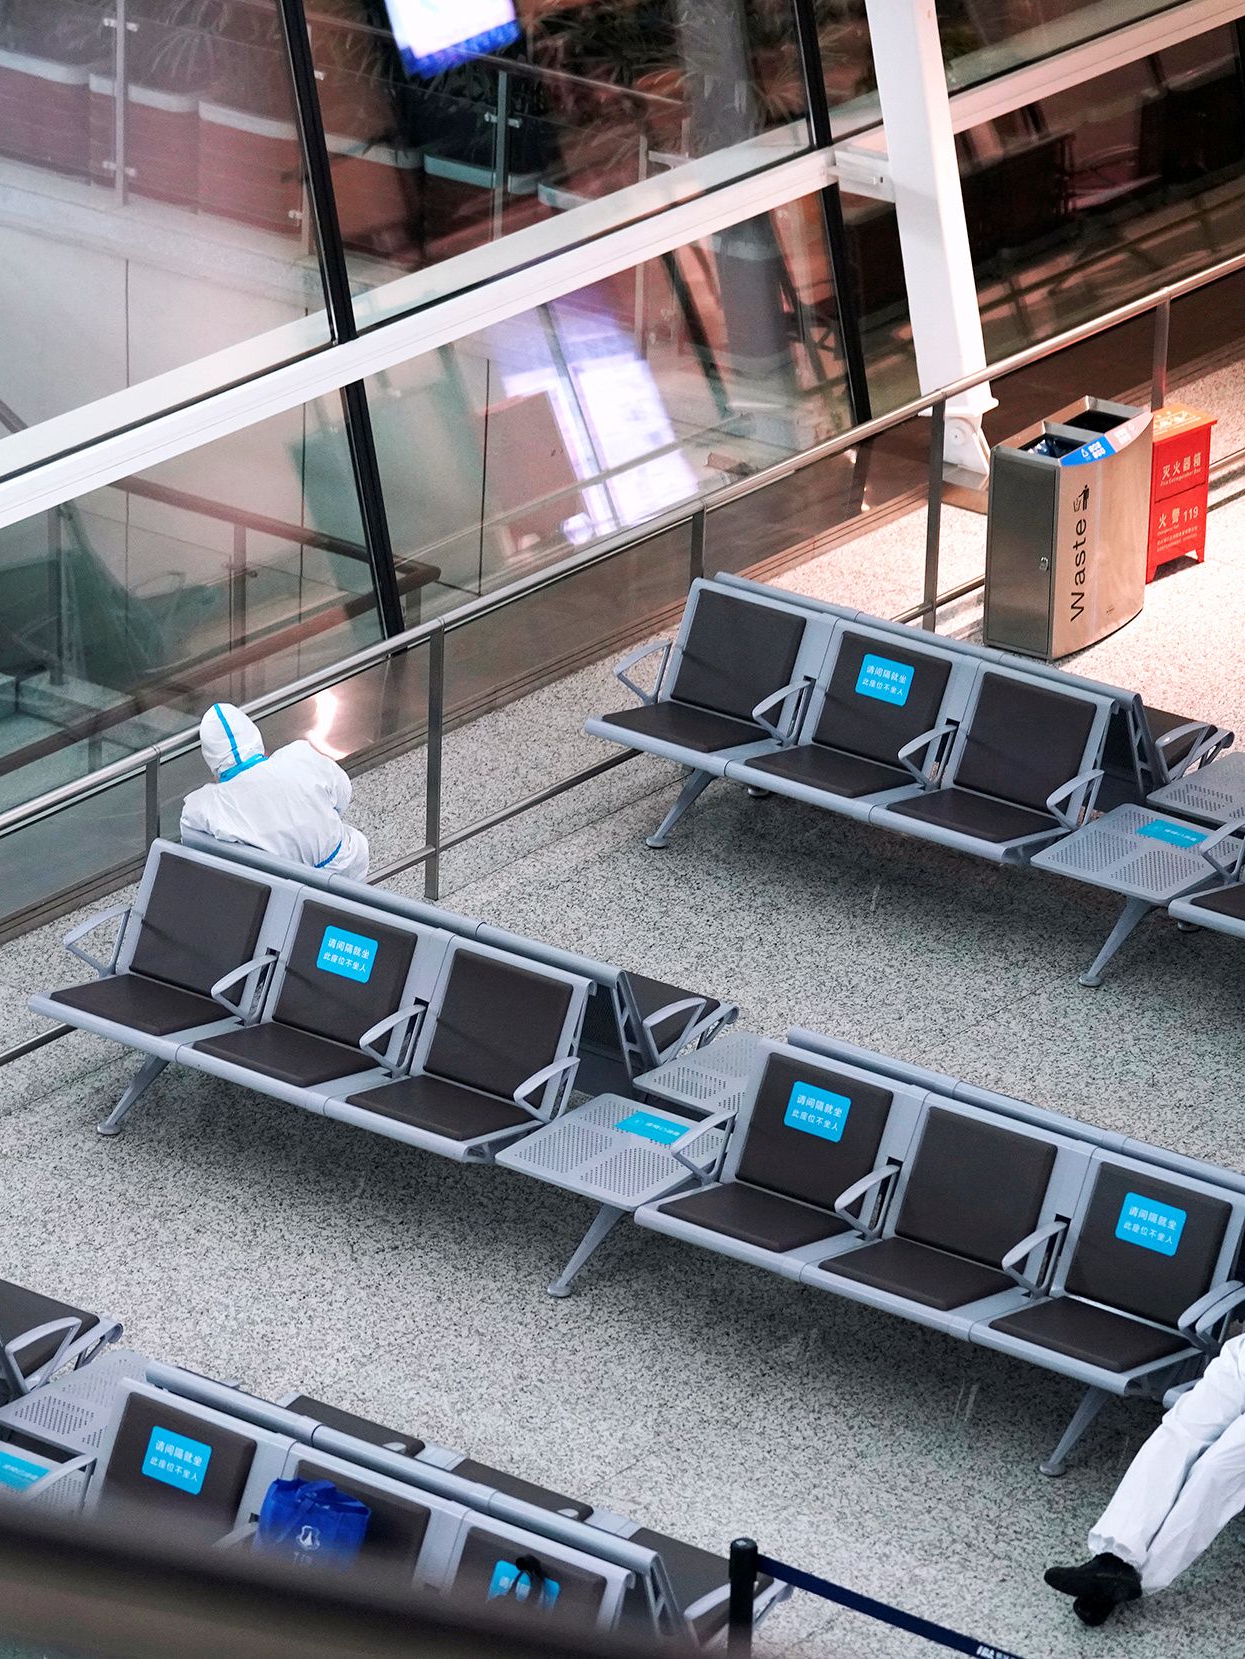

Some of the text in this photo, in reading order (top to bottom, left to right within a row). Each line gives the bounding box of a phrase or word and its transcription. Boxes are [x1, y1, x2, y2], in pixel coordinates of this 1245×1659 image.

[1162, 452, 1201, 480] 灭火器箱
[1183, 506, 1199, 522] 119
[1070, 519, 1087, 622] Waste
[866, 665, 906, 684] 请间隔就坐
[328, 937, 370, 959] 请间隔就坐
[797, 1094, 842, 1117] 请间隔就坐
[1128, 1206, 1176, 1230] 请间隔就坐
[156, 1439, 202, 1467] 请间隔就坐
